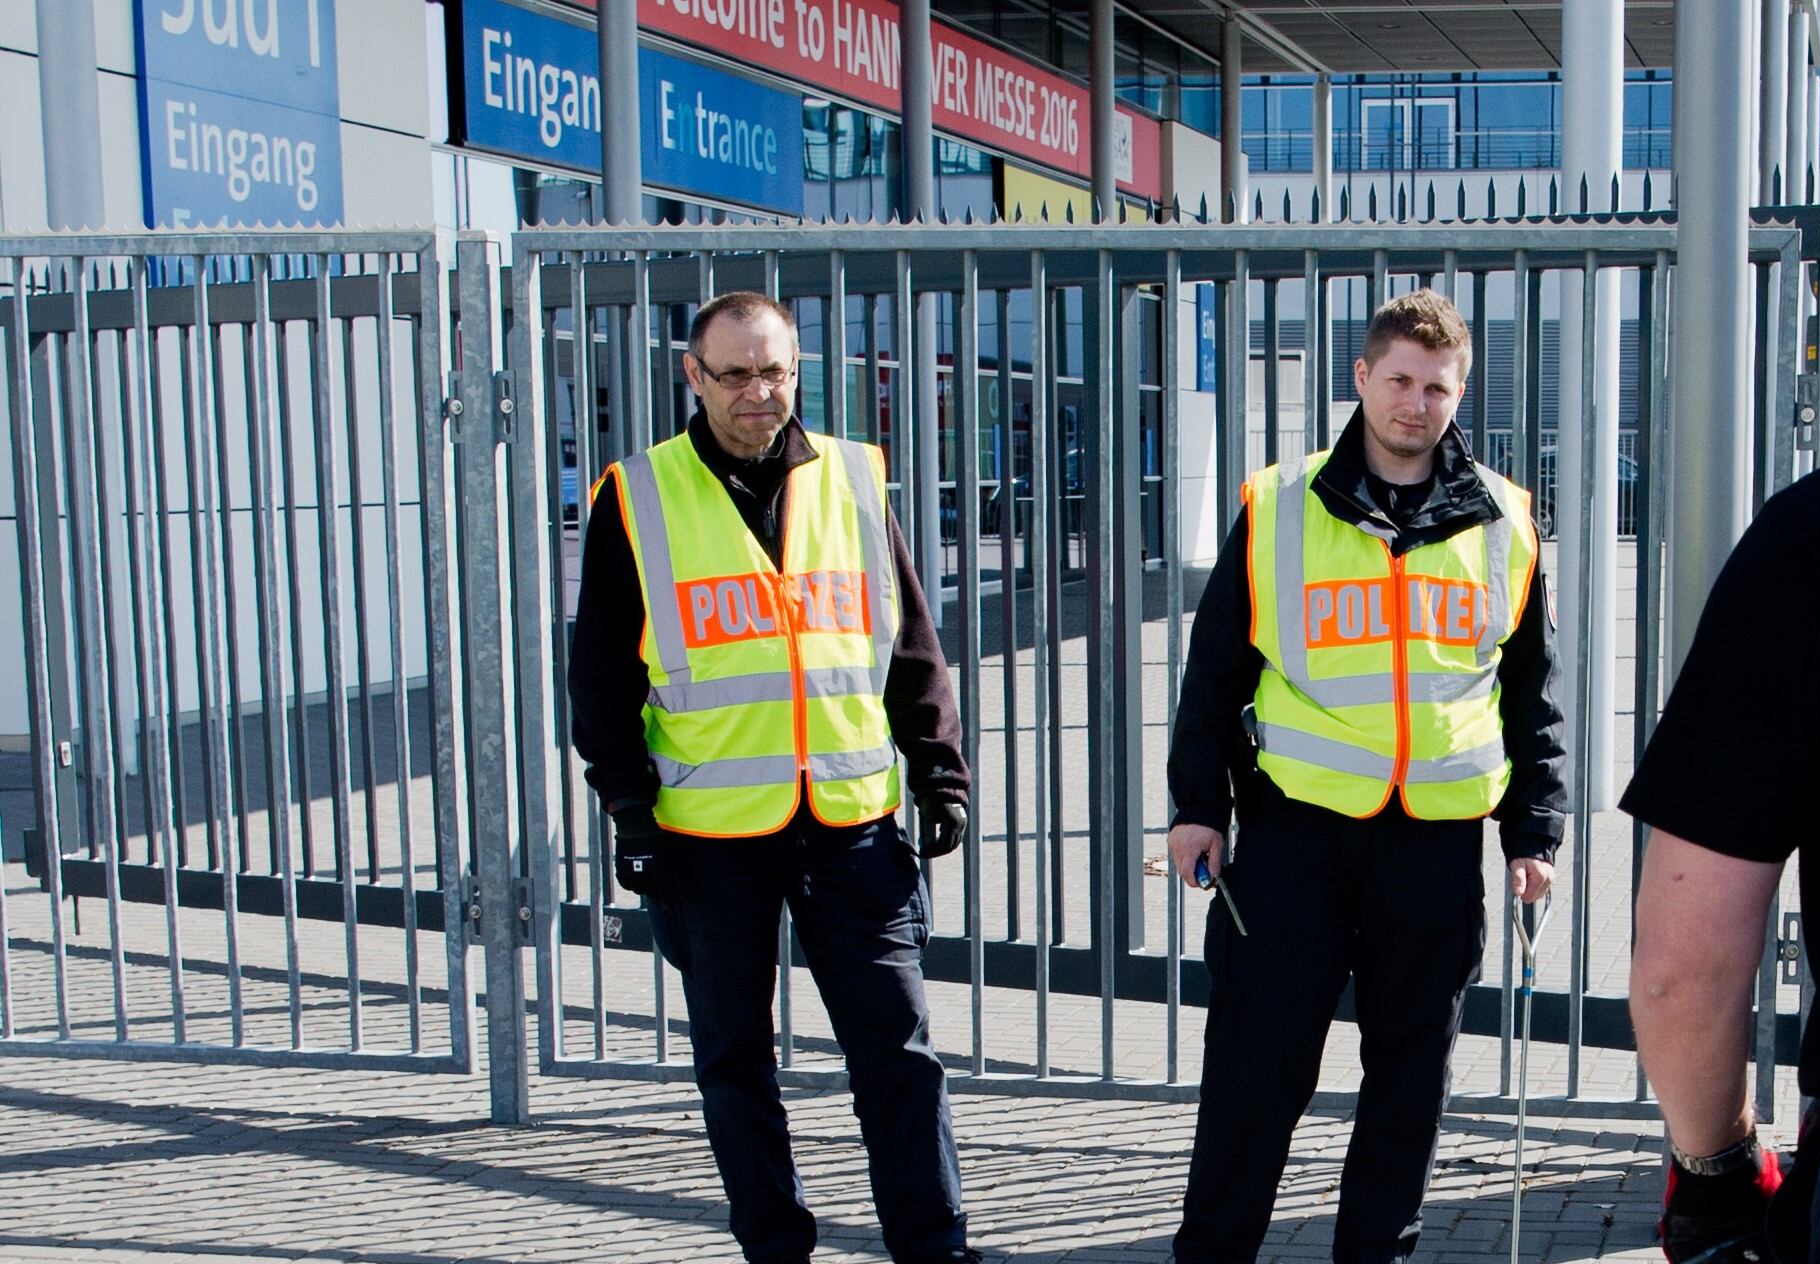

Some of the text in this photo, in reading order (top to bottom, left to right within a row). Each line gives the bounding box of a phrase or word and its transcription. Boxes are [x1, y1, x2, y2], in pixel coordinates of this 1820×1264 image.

[483, 27, 778, 175] Eingan Entrance
[795, 2, 826, 62] to
[833, 0, 968, 116] HANNVER
[974, 57, 1036, 142] MESSE
[1040, 85, 1078, 156] 2016
[165, 100, 318, 211] Eingang
